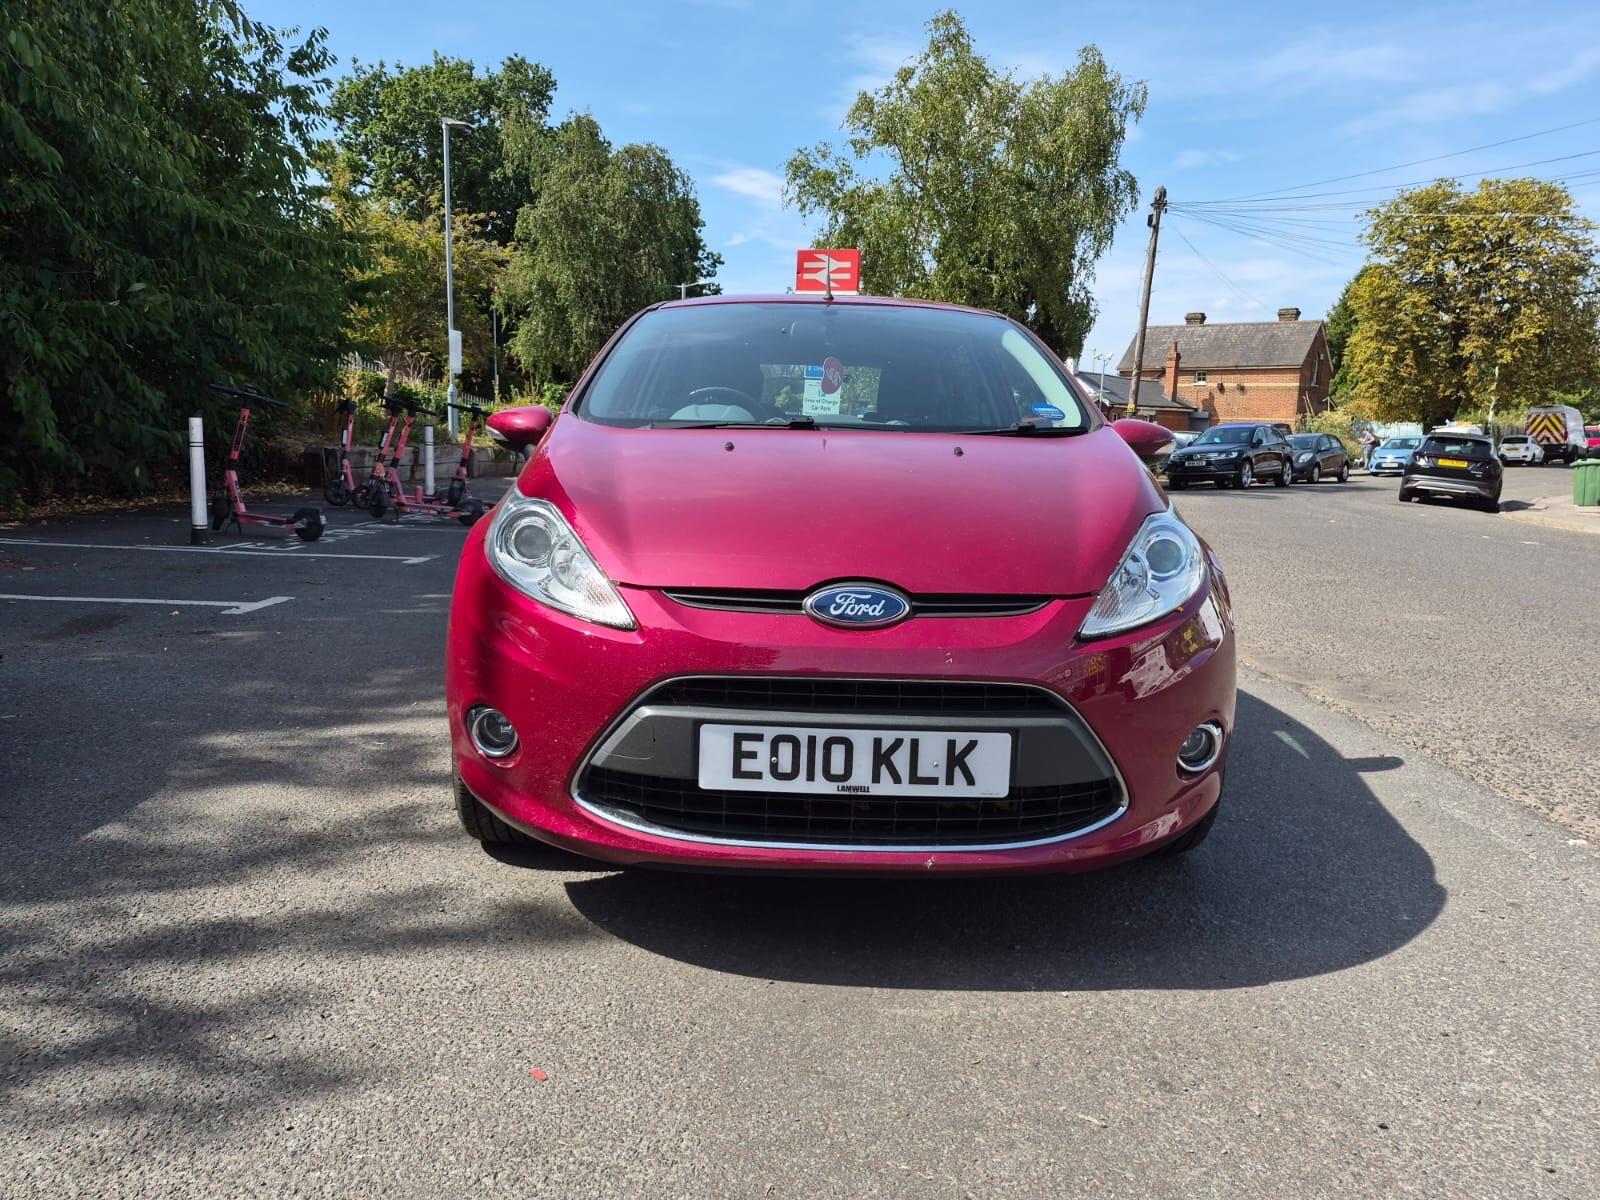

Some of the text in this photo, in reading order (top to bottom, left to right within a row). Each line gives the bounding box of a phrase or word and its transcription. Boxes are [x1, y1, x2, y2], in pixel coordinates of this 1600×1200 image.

[829, 592, 886, 616] Ford
[732, 731, 978, 786] EO10 KLK
[836, 784, 871, 794] LAMWELL
